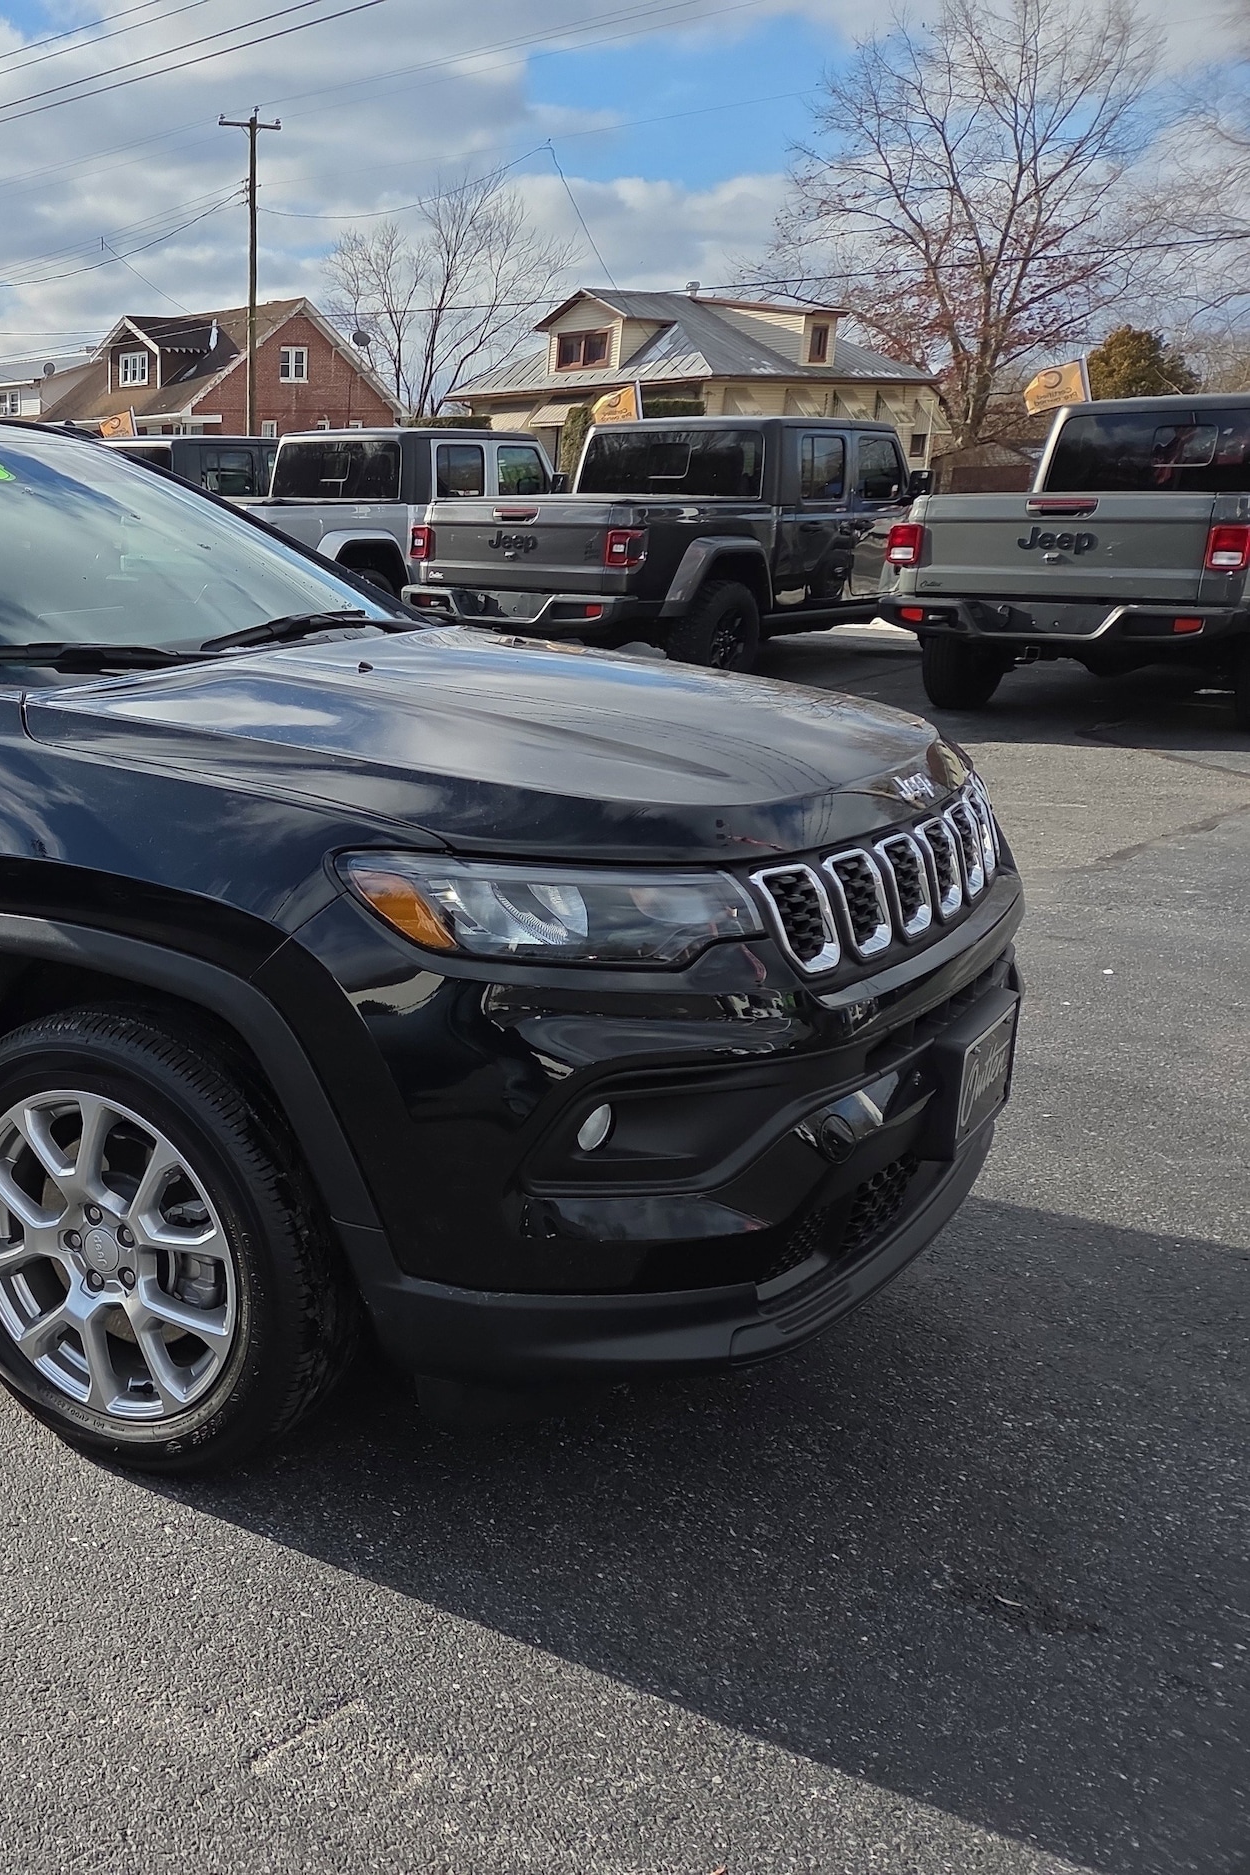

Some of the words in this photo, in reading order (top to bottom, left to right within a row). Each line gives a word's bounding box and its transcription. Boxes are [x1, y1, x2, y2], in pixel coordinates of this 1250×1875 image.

[488, 530, 538, 553] Jeep
[1017, 526, 1097, 555] Jeep
[93, 1234, 108, 1267] Jeep
